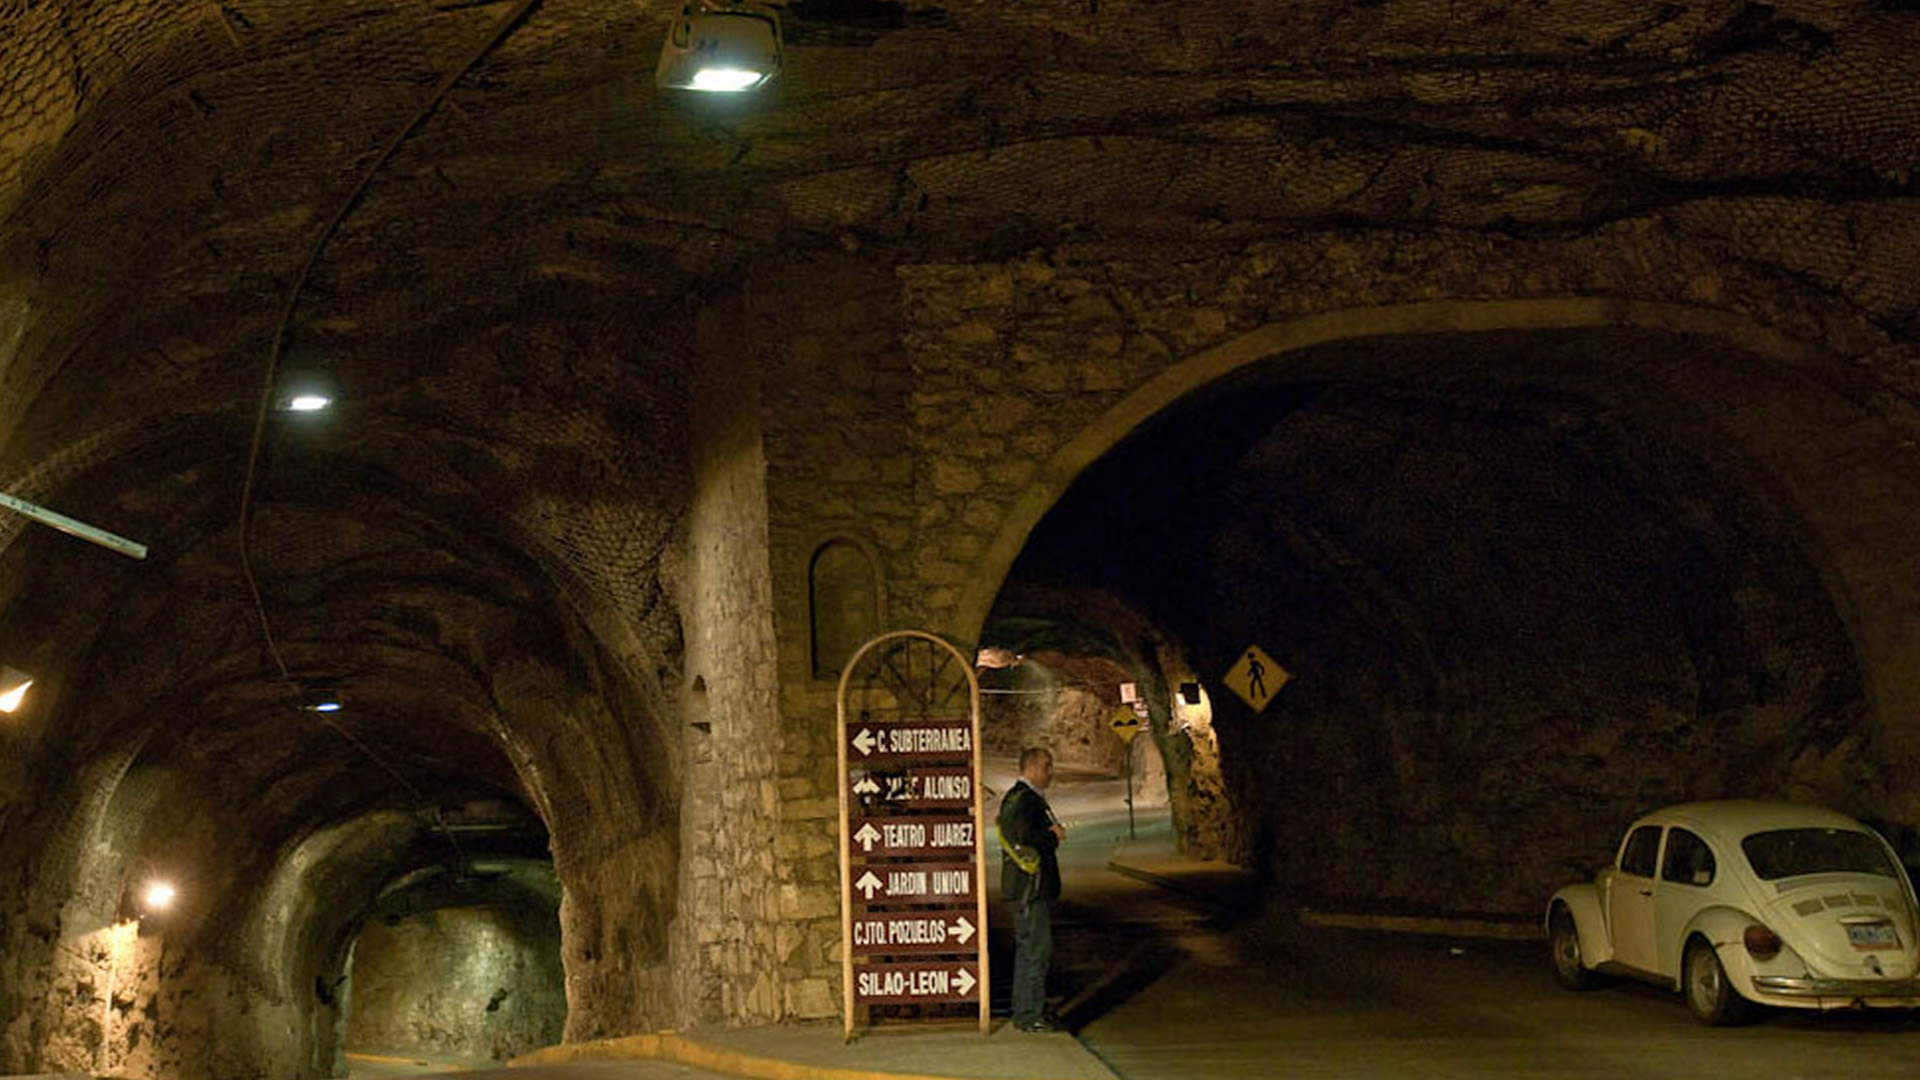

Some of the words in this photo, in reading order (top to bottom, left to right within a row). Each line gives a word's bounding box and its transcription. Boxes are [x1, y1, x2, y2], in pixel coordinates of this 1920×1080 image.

[877, 729, 888, 752] C.
[890, 728, 971, 752] SUBTERRANEA
[924, 776, 970, 798] ALONSO
[883, 824, 925, 847] TEATRO
[930, 823, 973, 847] JUAREZ
[886, 872, 927, 896] JARDIN
[933, 871, 969, 894] UNION
[889, 919, 946, 944] POZUELOS
[858, 971, 948, 996] SILAO-LEON
